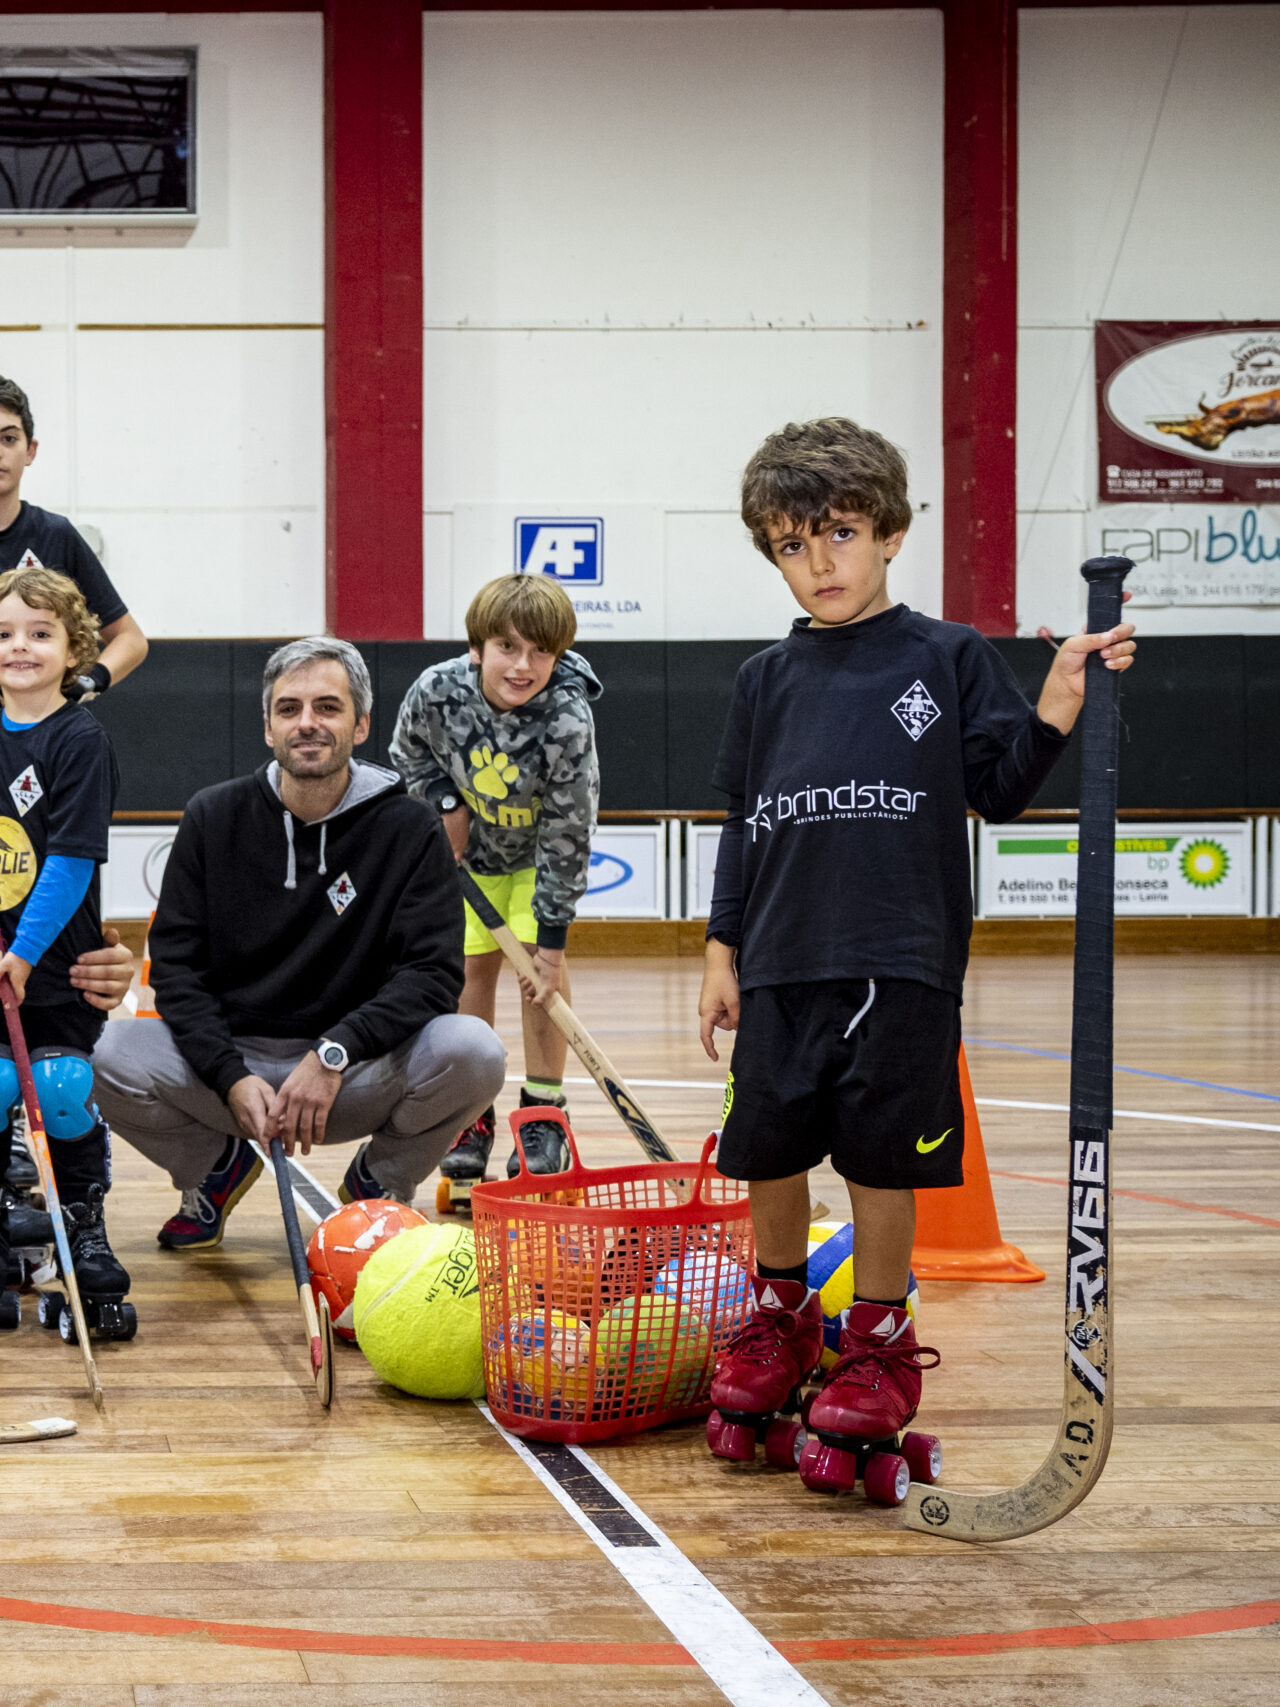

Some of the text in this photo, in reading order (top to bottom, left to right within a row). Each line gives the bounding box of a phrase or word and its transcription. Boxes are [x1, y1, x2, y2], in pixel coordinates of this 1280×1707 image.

[523, 526, 596, 576] AF
[617, 600, 642, 613] LDA
[777, 779, 927, 820] brindstar
[1147, 855, 1170, 872] bp
[998, 878, 1054, 892] Adelino
[1115, 878, 1169, 891] onseca
